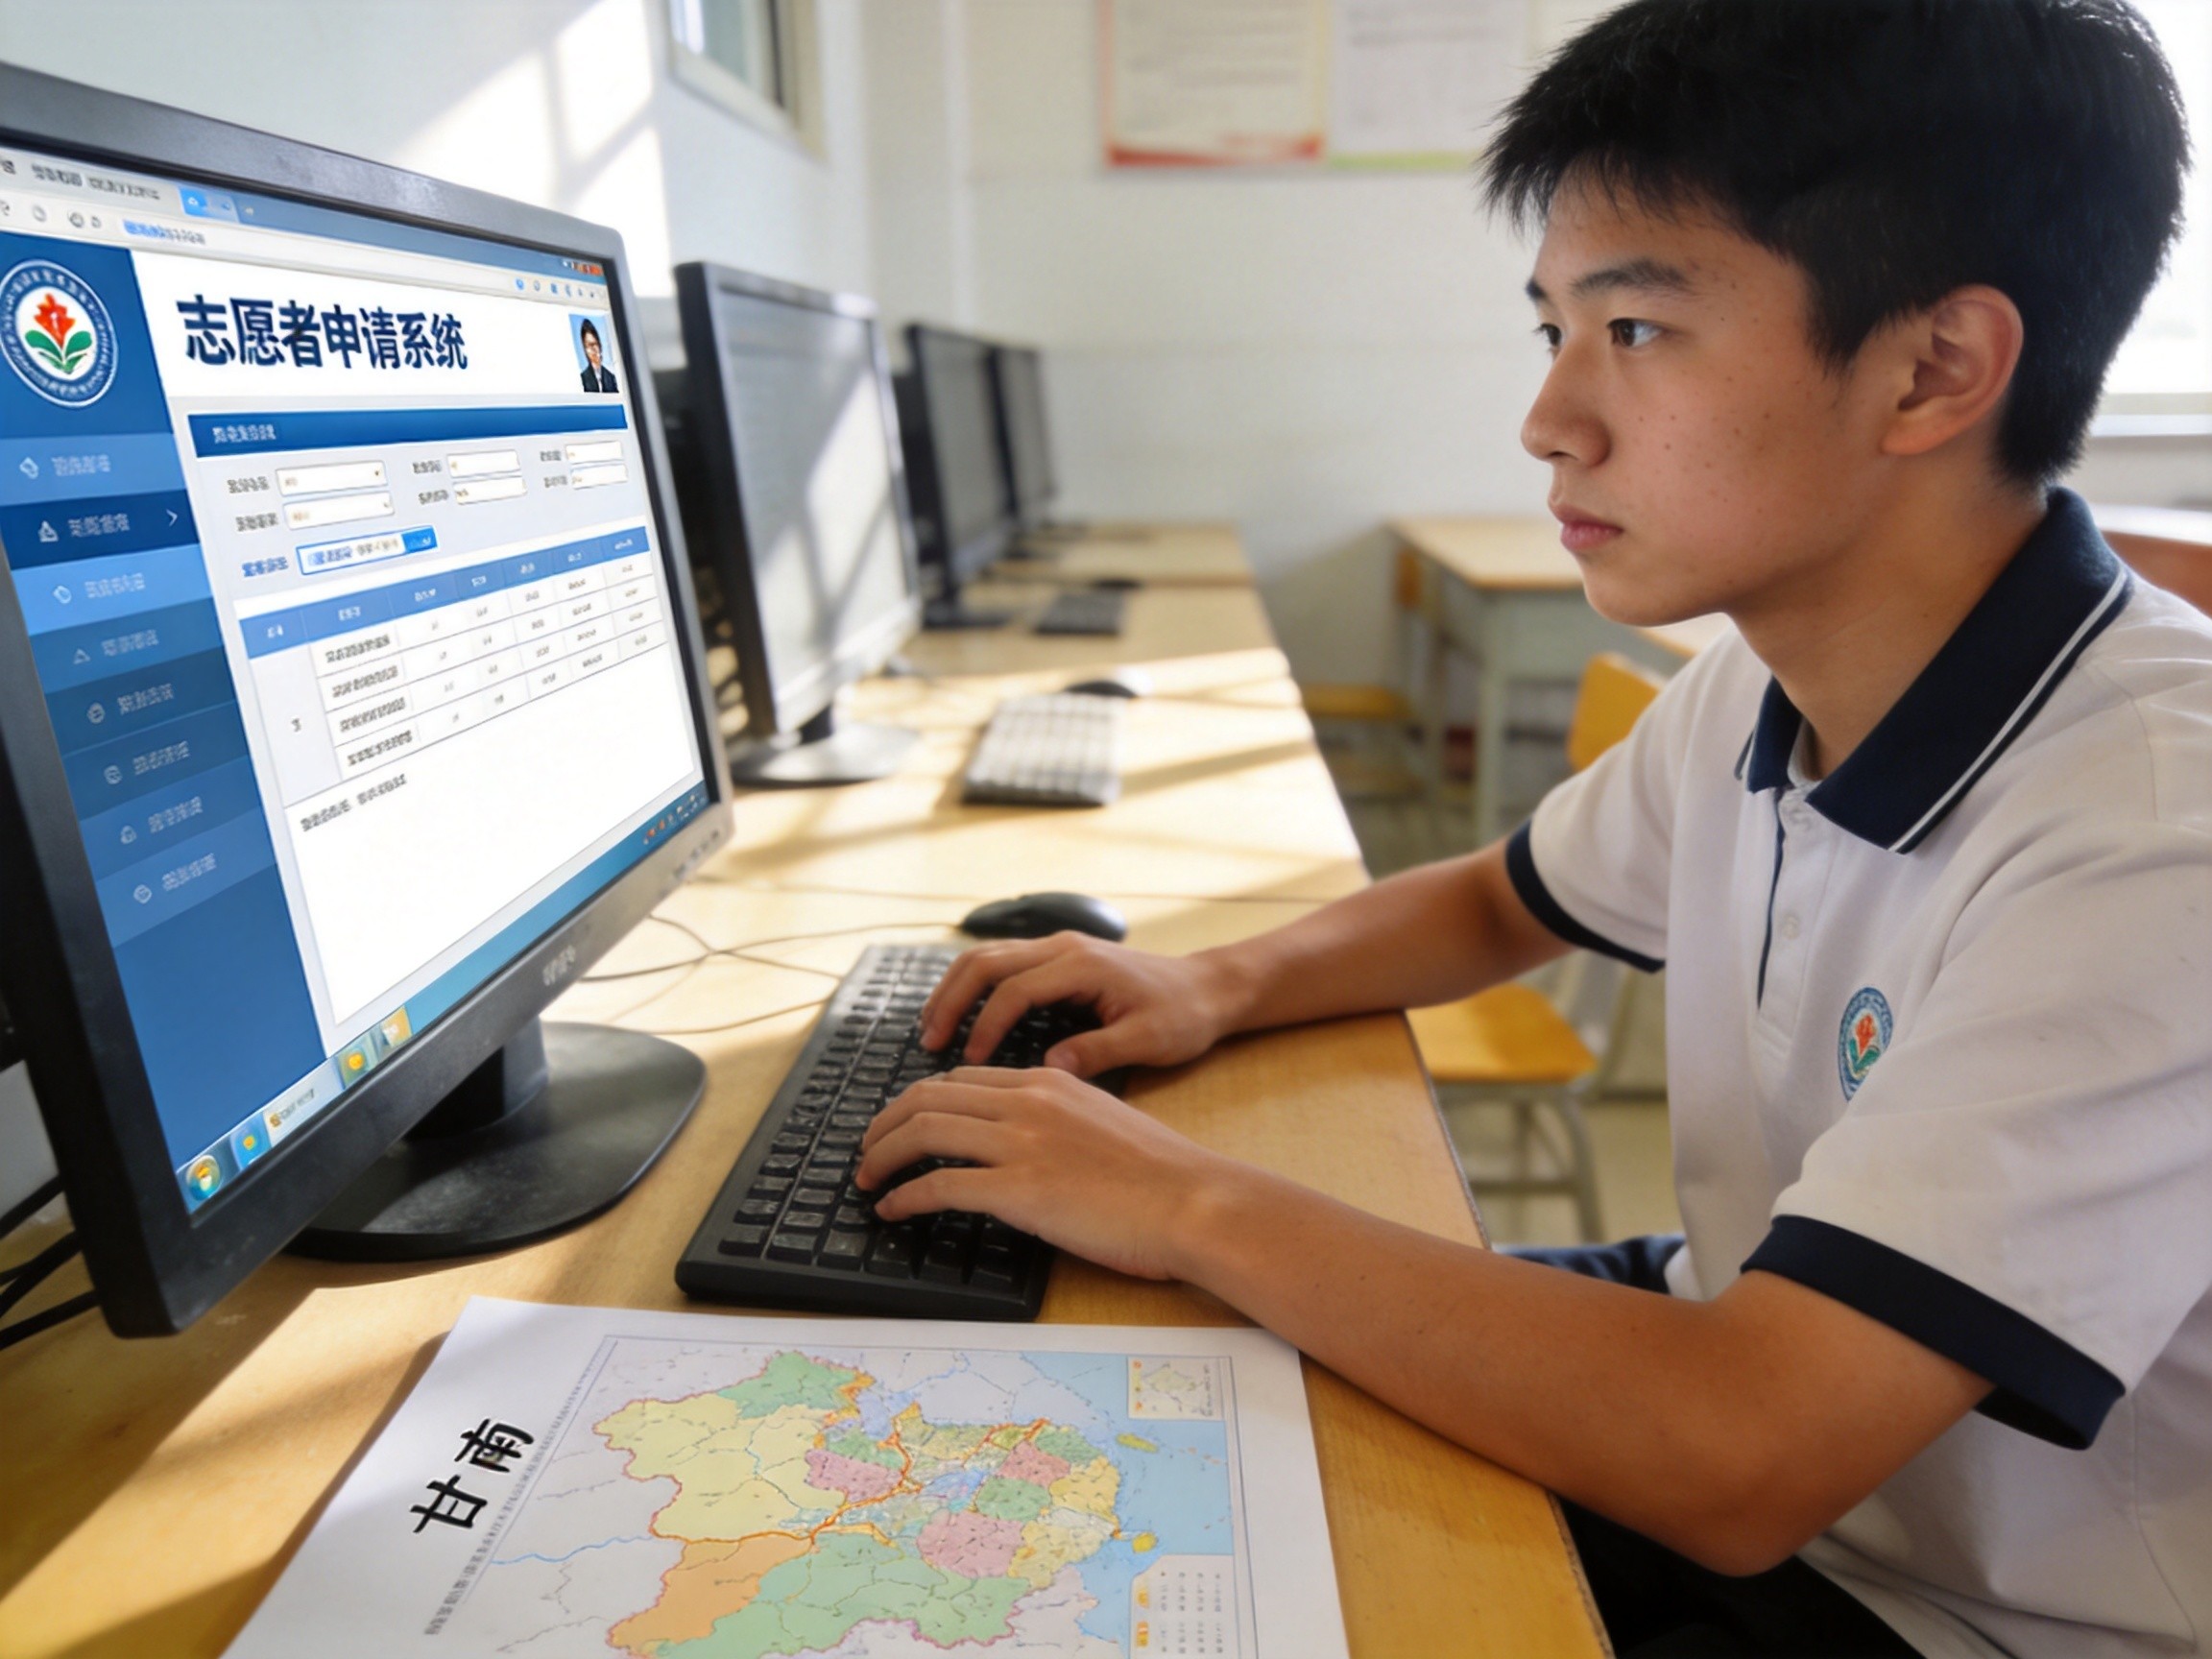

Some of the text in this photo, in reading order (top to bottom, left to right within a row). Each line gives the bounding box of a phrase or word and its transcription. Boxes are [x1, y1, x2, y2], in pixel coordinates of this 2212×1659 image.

[177, 294, 468, 369] 志愿者申请系统
